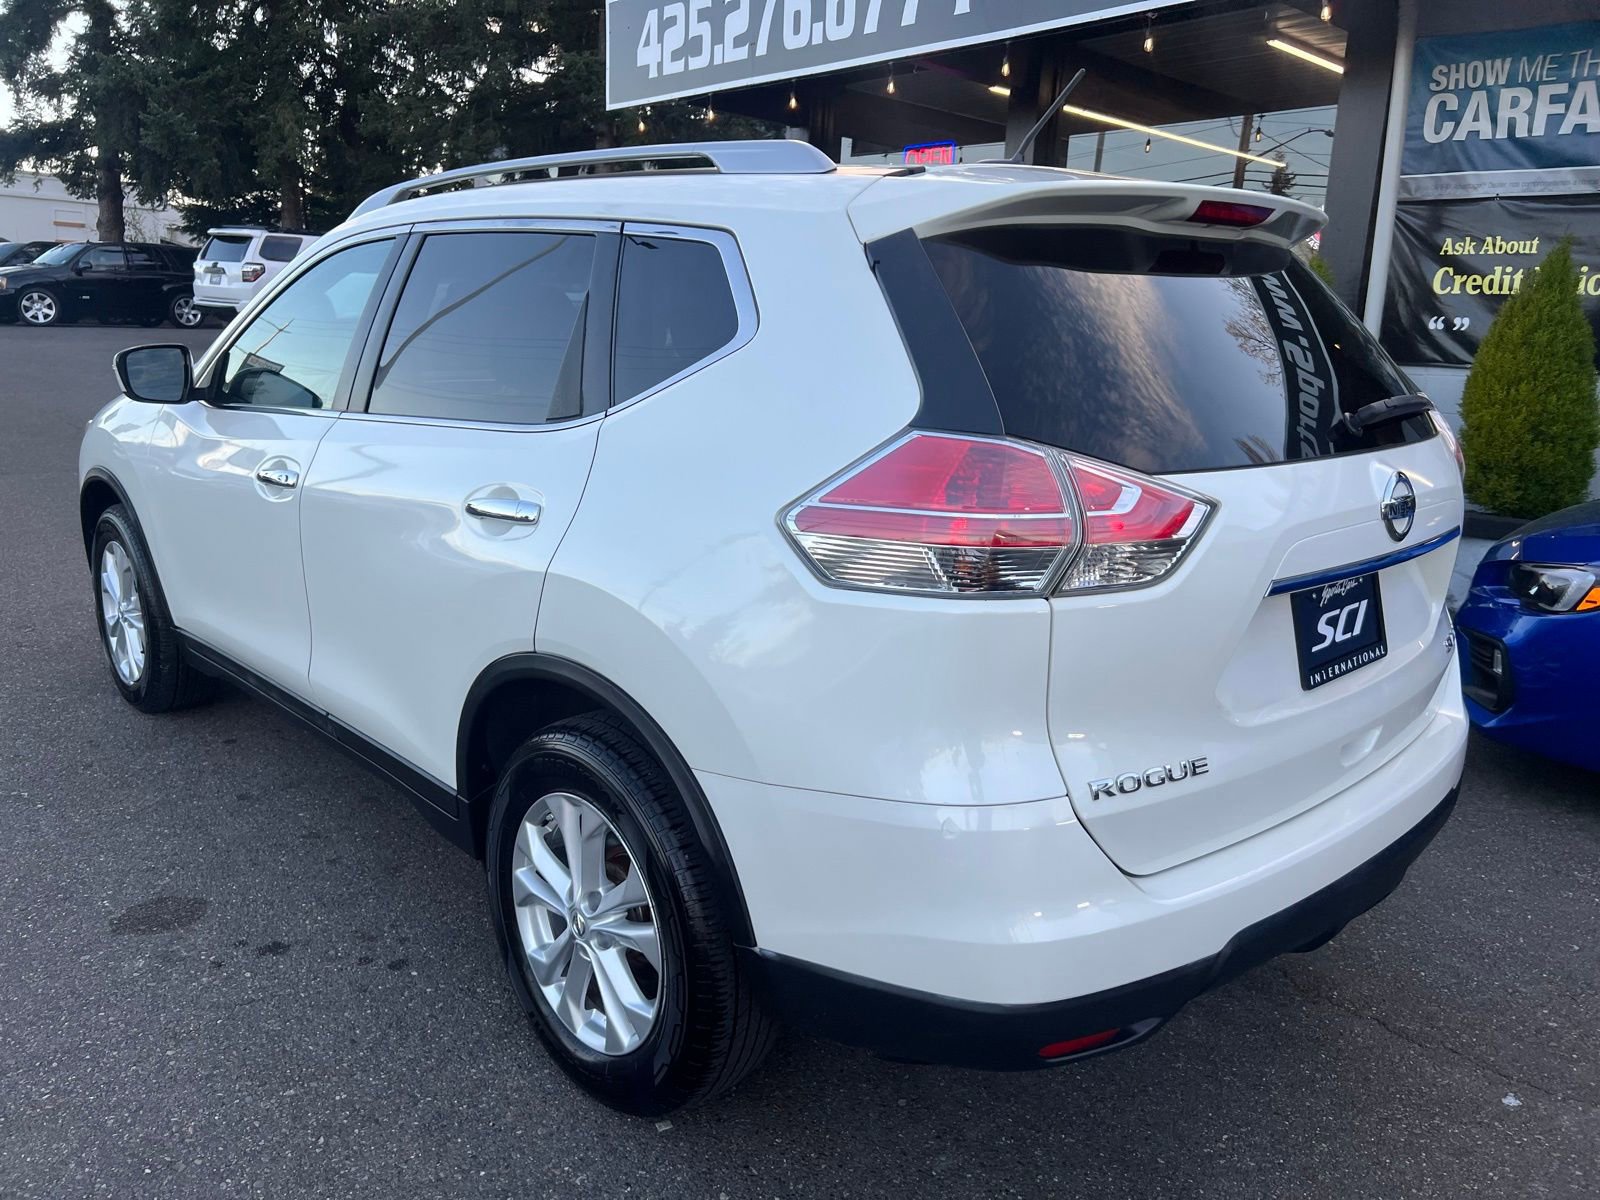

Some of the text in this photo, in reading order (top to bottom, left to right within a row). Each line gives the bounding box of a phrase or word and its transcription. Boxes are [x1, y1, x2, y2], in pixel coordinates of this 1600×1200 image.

[1429, 57, 1512, 92] SHOW
[1518, 53, 1562, 83] ME
[1440, 235, 1540, 256] Ask About
[1432, 266, 1524, 295] Credit
[1311, 599, 1369, 653] SCI
[1309, 645, 1386, 686] INTERNATIONAL
[1088, 756, 1210, 801] ROGUE
